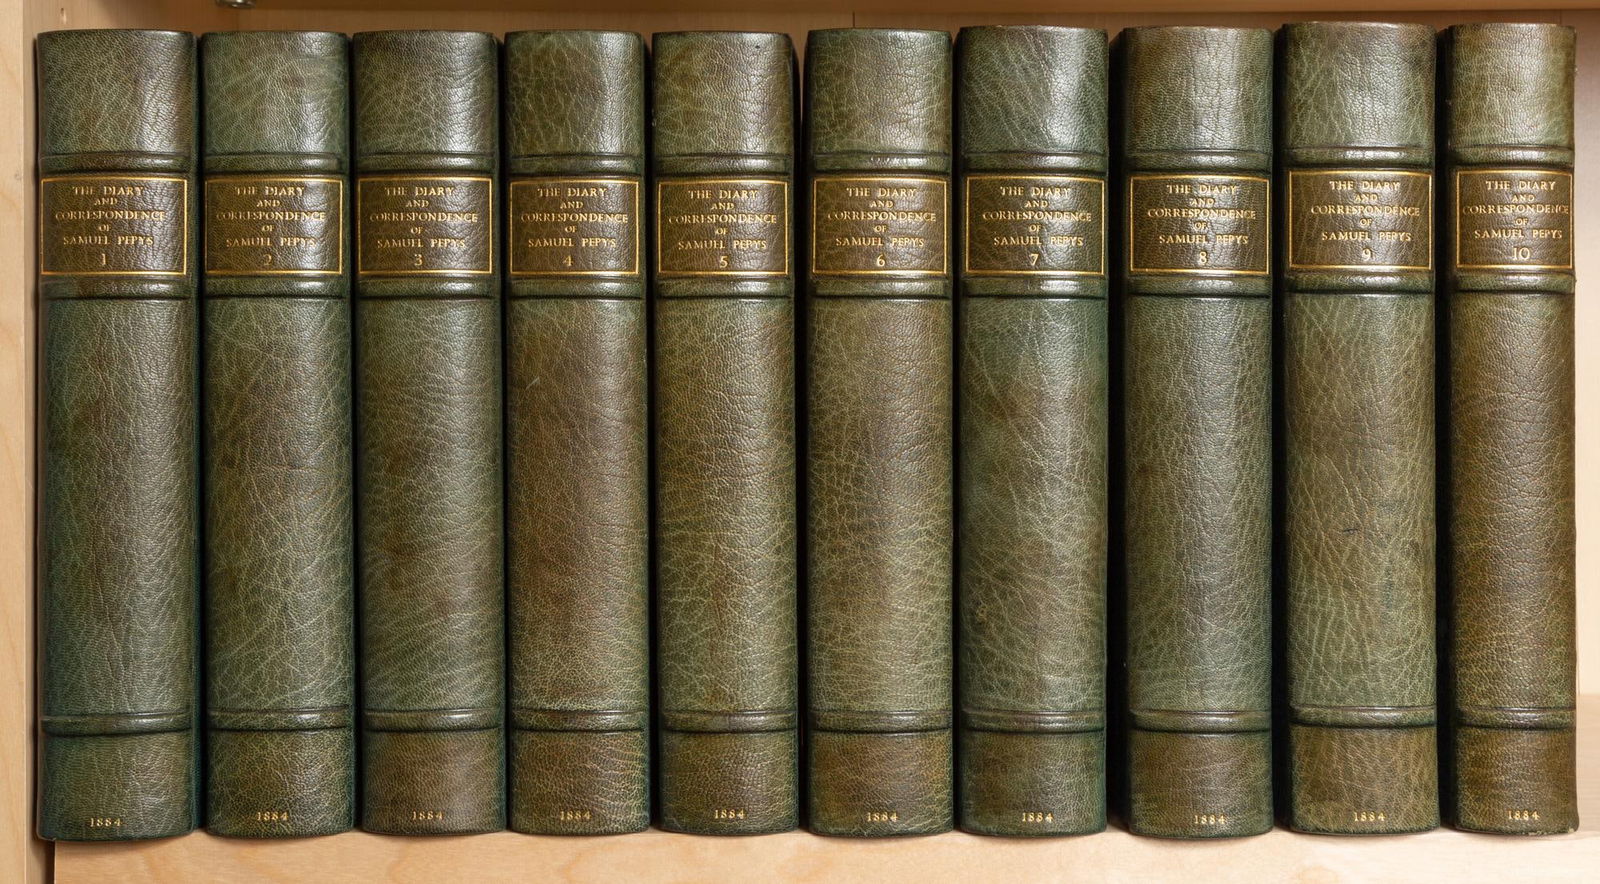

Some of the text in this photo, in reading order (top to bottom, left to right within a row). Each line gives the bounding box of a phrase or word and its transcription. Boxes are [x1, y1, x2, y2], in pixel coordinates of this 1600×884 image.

[1166, 185, 1237, 194] THE DIARY
[1330, 181, 1400, 190] THE DIARY
[1485, 181, 1556, 190] THE DIARY
[72, 186, 144, 197] THE DIARY
[235, 186, 305, 197] THE DIARY
[384, 186, 455, 197] THE DIARY
[537, 187, 606, 198] THE DIARY
[688, 189, 758, 199] THE DIARY
[847, 187, 916, 197] THE DIARY
[1000, 186, 1071, 197] THE DIARY
[1355, 194, 1378, 202] AND
[257, 199, 280, 208] AND
[406, 200, 429, 208] AND
[560, 201, 583, 209] AND
[870, 200, 893, 208] AND
[1026, 200, 1049, 208] AND
[1147, 209, 1256, 220] CORRESPONDENCE
[1311, 205, 1420, 216] CORRESPONDENCE
[1463, 205, 1569, 214] CORRESPONDENCE
[55, 211, 166, 221] CORRESPONDENCE
[216, 212, 325, 222] CORRESPONDENCE
[370, 212, 478, 222] CORRESPONDENCE
[521, 213, 628, 223] CORRESPONDENCE
[668, 214, 776, 225] CORRESPONDENCE
[827, 211, 936, 222] CORRESPONDENCE
[983, 211, 1091, 222] CORRESPONDENCE
[1360, 218, 1372, 226] OF
[99, 224, 111, 232] OF
[262, 224, 274, 232] OF
[411, 226, 423, 234] OF
[566, 225, 577, 233] OF
[875, 225, 887, 233] OF
[1030, 224, 1042, 232] OF
[1159, 234, 1248, 244] SAMUEL PEPYS
[1322, 231, 1412, 241] SAMUEL PEPYS
[1475, 229, 1562, 239] SAMUEL PEPYS
[63, 235, 153, 246] SAMUEL PEPYS
[226, 237, 317, 248] SAMUEL PEPYS
[377, 238, 466, 249] SAMUEL PEPYS
[528, 237, 616, 248] SAMUEL PEPYS
[678, 239, 767, 250] SAMUEL PEPYS
[836, 236, 925, 247] SAMUEL PEPYS
[993, 236, 1083, 246] SAMUEL PEPYS
[1199, 251, 1207, 264] 8
[1362, 249, 1371, 261] 9
[1512, 247, 1530, 260] 10
[101, 254, 107, 265] 1
[263, 254, 273, 265] 2
[414, 254, 423, 266] 3
[562, 255, 573, 267] 4
[719, 255, 728, 268] 5
[876, 254, 886, 267] 6
[1030, 254, 1039, 266] 7
[257, 811, 289, 821] 1884
[412, 811, 444, 820] 1884
[560, 810, 591, 820] 1884
[714, 809, 745, 819] 1884
[867, 811, 898, 822] 1884
[1022, 812, 1054, 823] 1884
[1194, 814, 1226, 824] 1884
[1354, 812, 1385, 822] 1884
[1508, 810, 1540, 820] 1884
[89, 817, 122, 827] 1884
